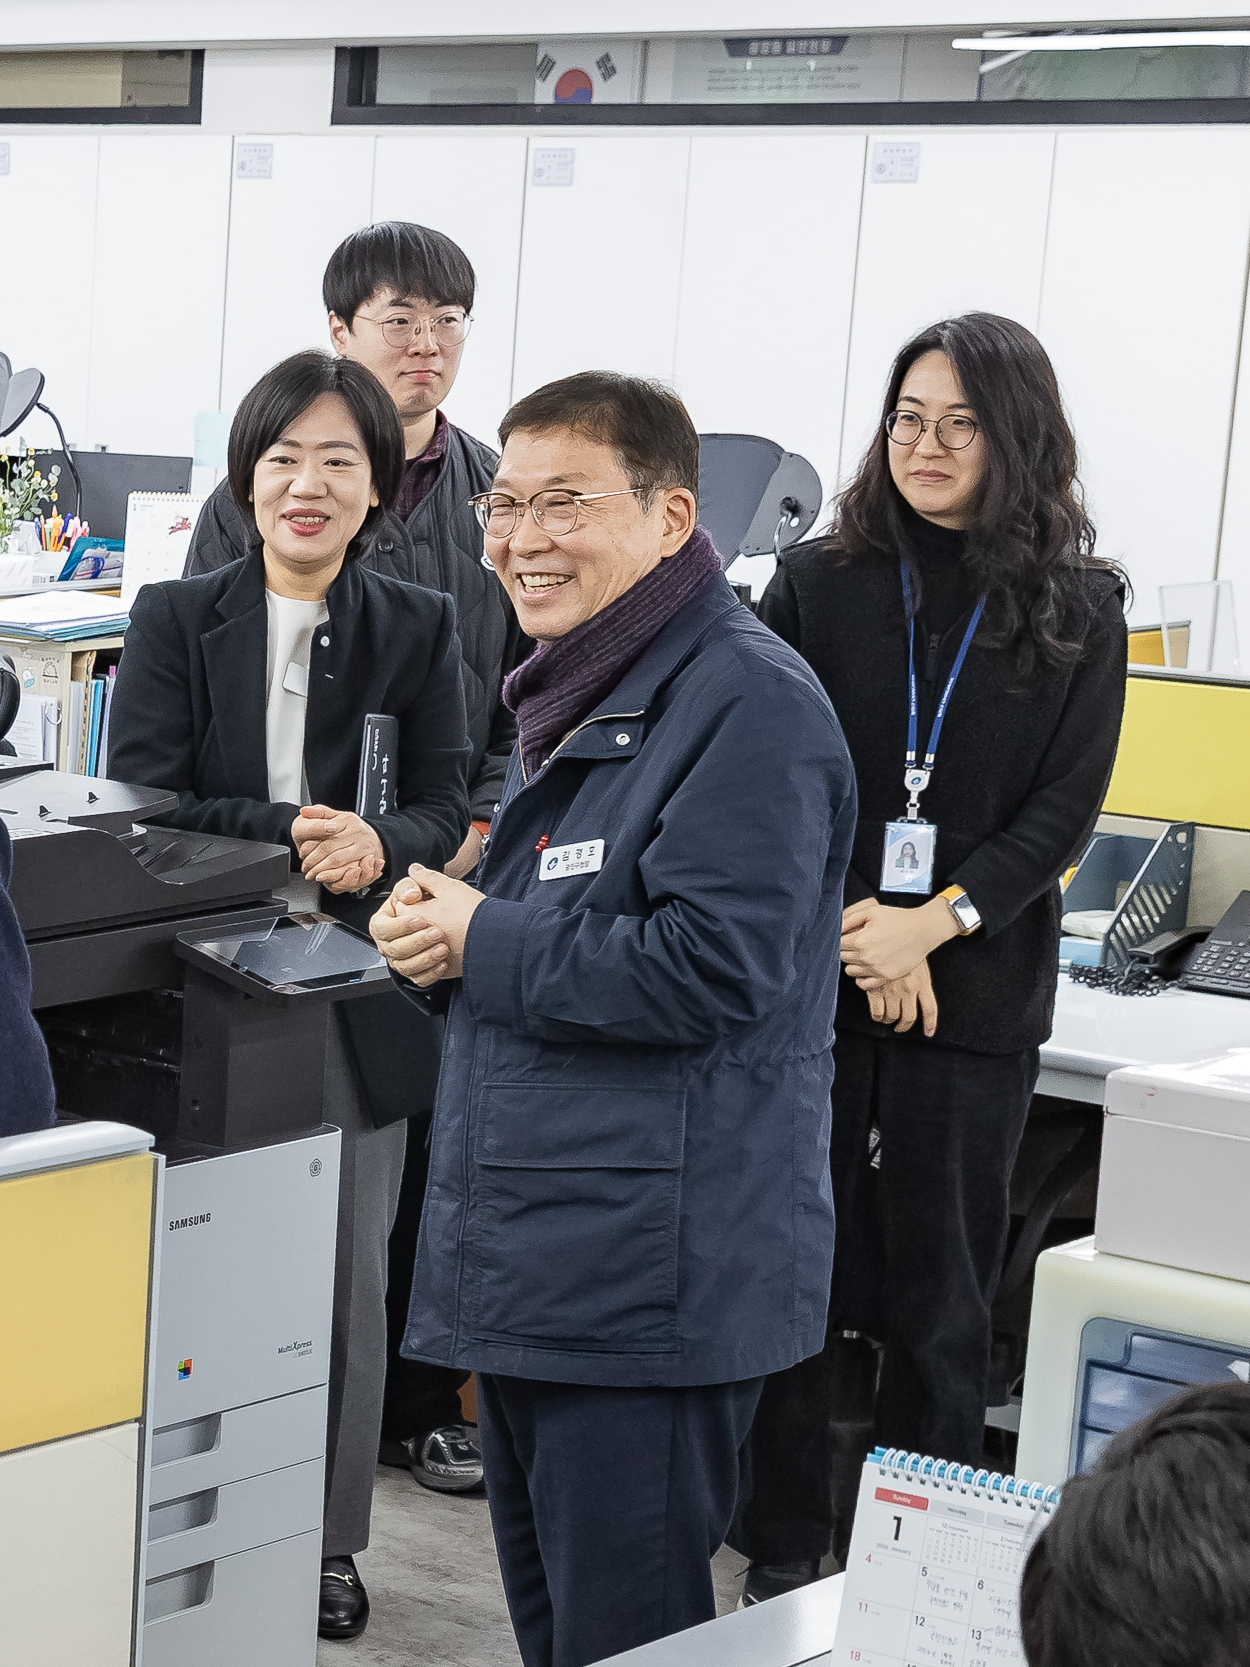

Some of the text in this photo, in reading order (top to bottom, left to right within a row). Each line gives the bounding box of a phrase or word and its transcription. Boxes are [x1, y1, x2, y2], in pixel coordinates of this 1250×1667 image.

[168, 1212, 212, 1232] SAMSUNG
[892, 1515, 903, 1542] 1
[865, 1553, 872, 1564] 4
[921, 1566, 928, 1577] 5
[977, 1579, 984, 1590] 6
[858, 1601, 869, 1613] 11
[915, 1615, 926, 1627] 12
[970, 1628, 982, 1641] 13
[850, 1650, 861, 1662] 18
